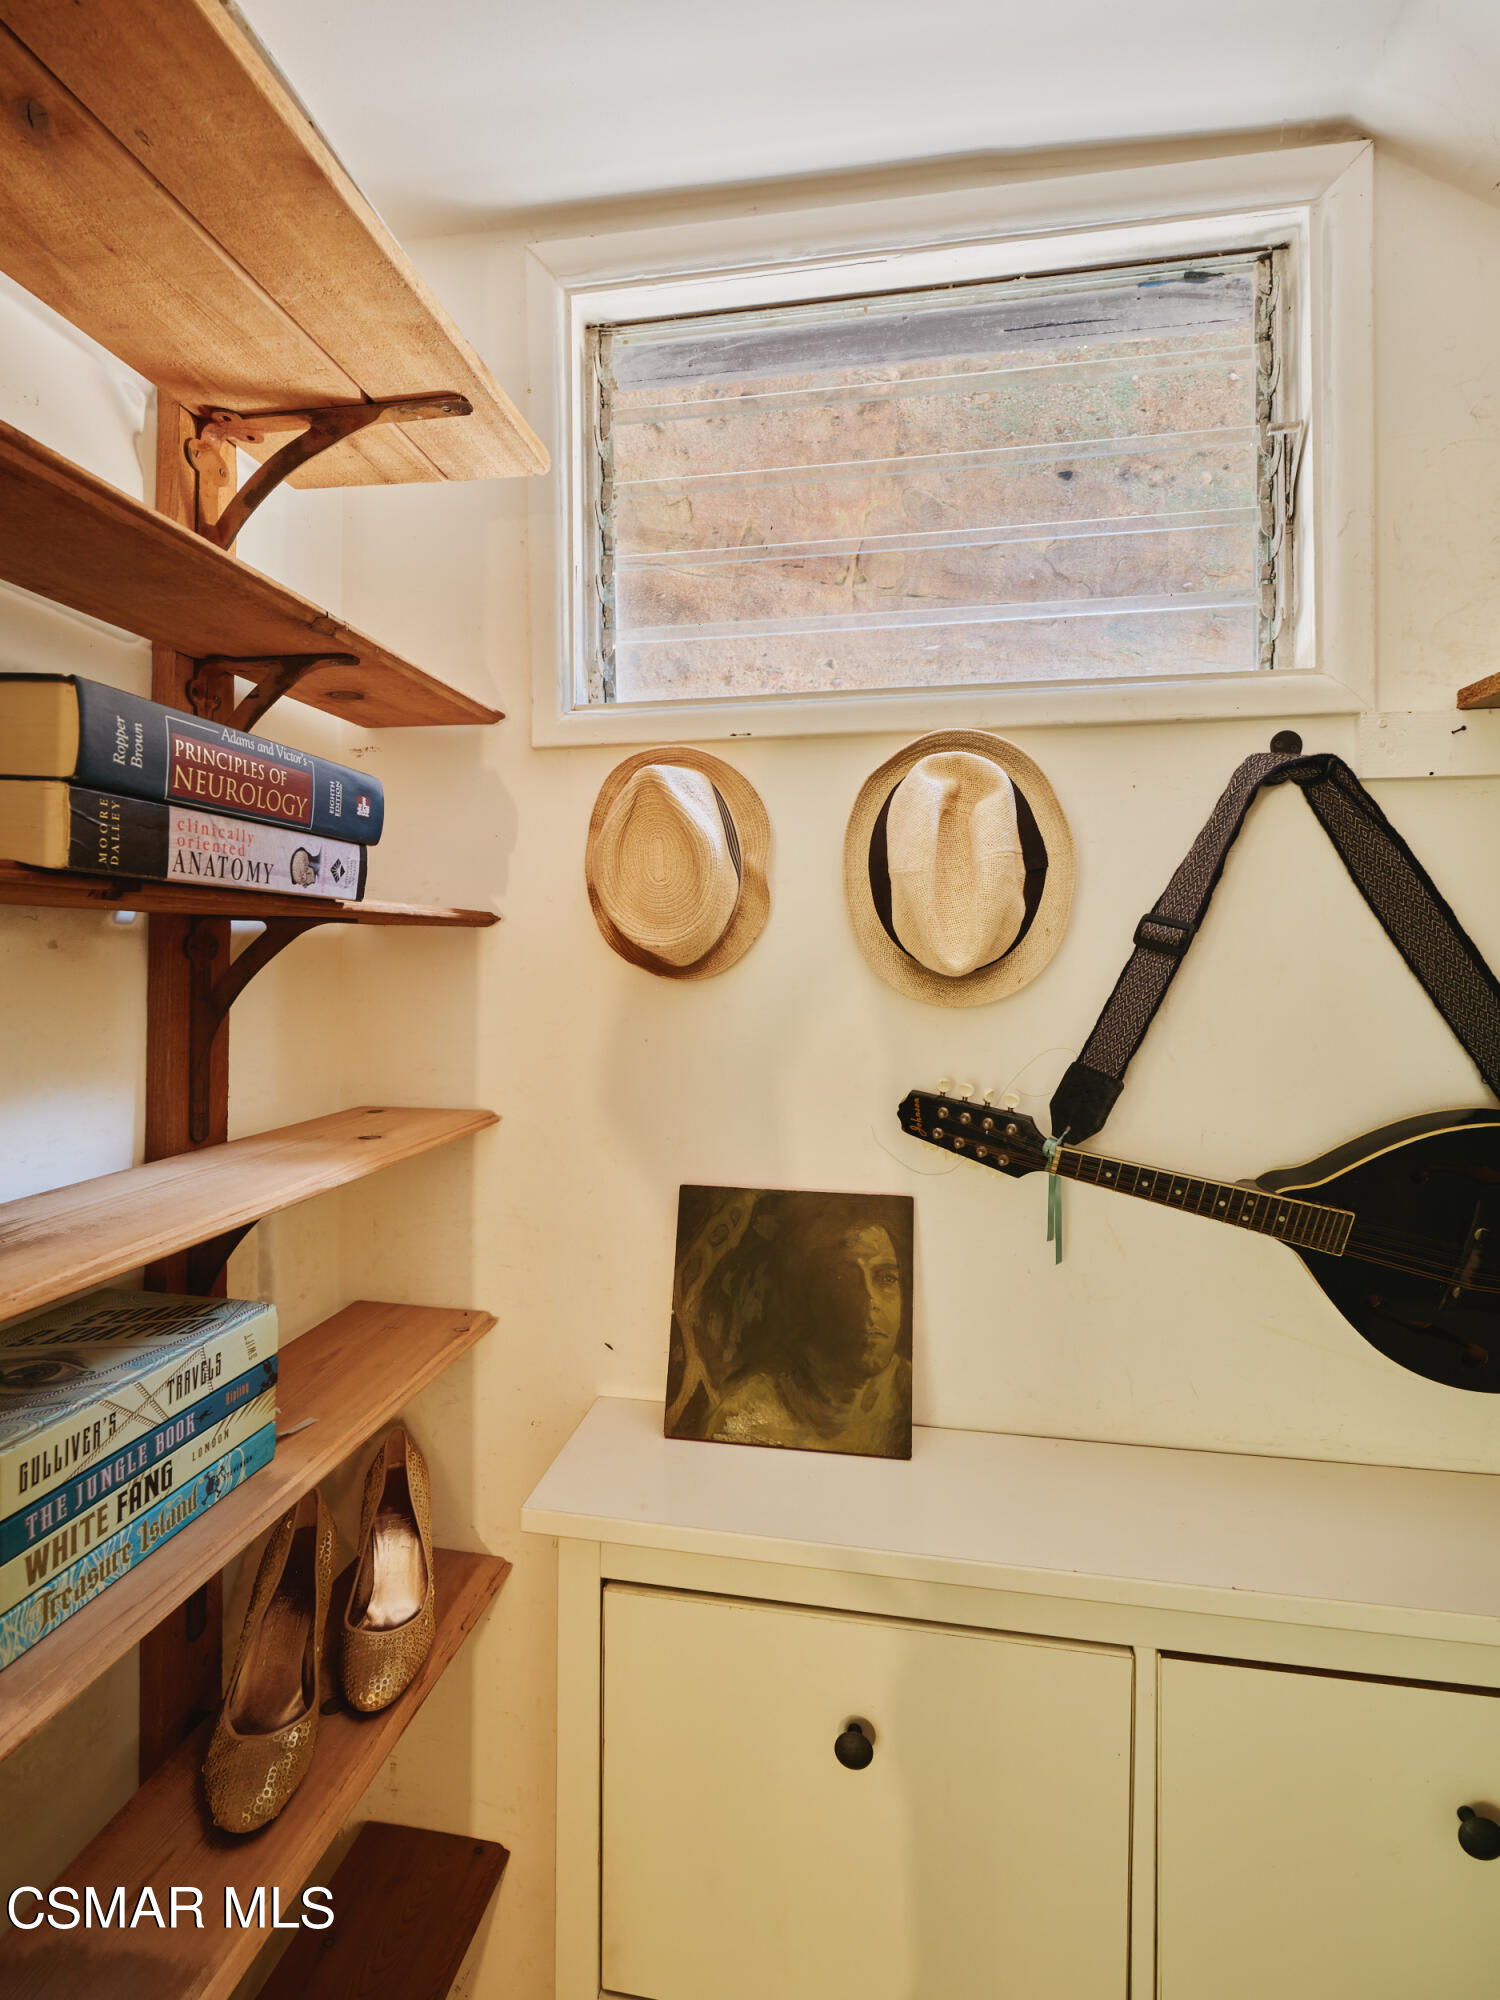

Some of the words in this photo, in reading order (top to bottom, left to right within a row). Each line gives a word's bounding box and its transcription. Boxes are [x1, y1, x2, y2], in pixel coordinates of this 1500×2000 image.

[113, 715, 128, 766] Ropper
[130, 722, 143, 768] Brown
[175, 739, 265, 781] PRINCIPLES
[269, 768, 288, 786] OF
[221, 728, 255, 750] Adams
[257, 742, 274, 756] and
[276, 745, 308, 767] Victor's
[173, 765, 308, 817] NEUROLOGY
[98, 798, 109, 864] MOORE
[110, 801, 121, 866] DALLEY
[176, 835, 246, 857] oriented
[177, 818, 254, 847] clinically
[172, 849, 274, 884] ANATOMY
[18, 1411, 118, 1496] GULLIVER'S
[167, 1352, 222, 1405] TRAVELS
[192, 1428, 230, 1462] LONDON
[24, 1493, 67, 1542] THE
[73, 1442, 148, 1512] JUNGLE
[154, 1411, 196, 1458] BOOK
[25, 1503, 108, 1587] WHITE
[117, 1460, 173, 1524] FANG
[27, 1542, 132, 1637] Treasure
[137, 1480, 199, 1554] Island
